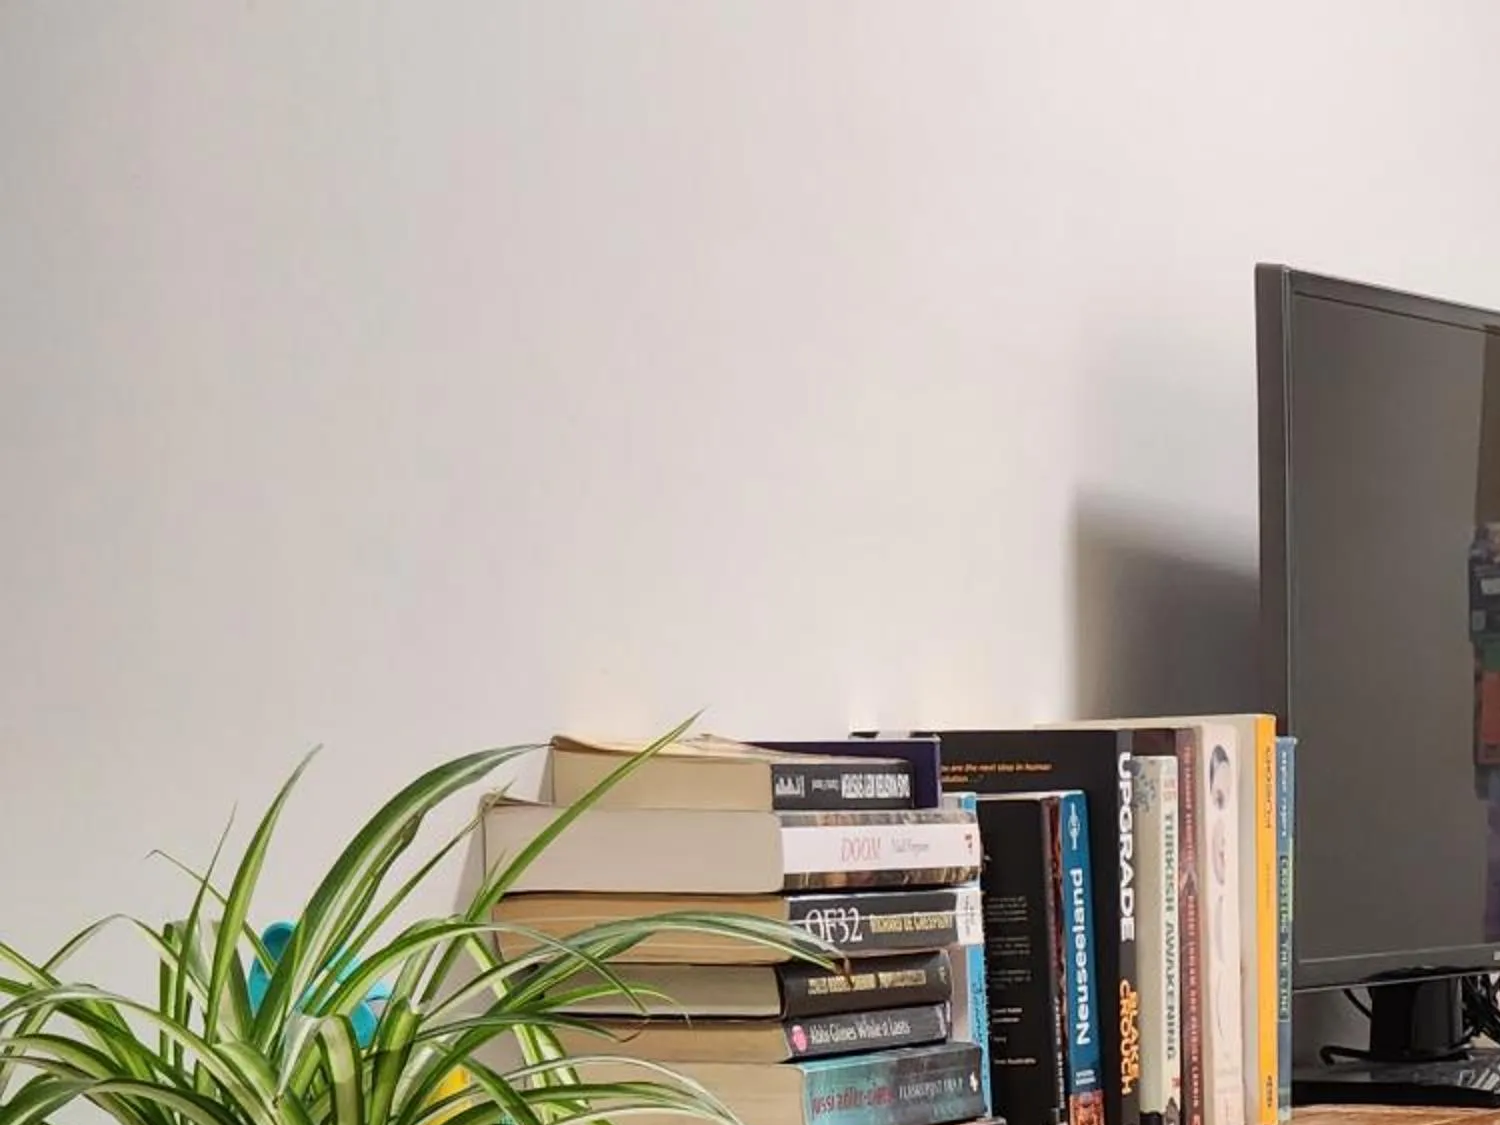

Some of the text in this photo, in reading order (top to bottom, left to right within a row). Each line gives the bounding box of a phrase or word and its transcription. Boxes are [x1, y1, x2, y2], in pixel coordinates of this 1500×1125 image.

[1118, 752, 1134, 941] UPGRADE
[1164, 812, 1176, 913] TURKISH
[1069, 868, 1090, 1045] Neuseeland
[1165, 919, 1178, 1061] AWAKENING
[1279, 855, 1290, 1018] CROSSING THE LINE
[1119, 979, 1133, 1095] CROUCH
[1129, 990, 1140, 1080] BLAKE
